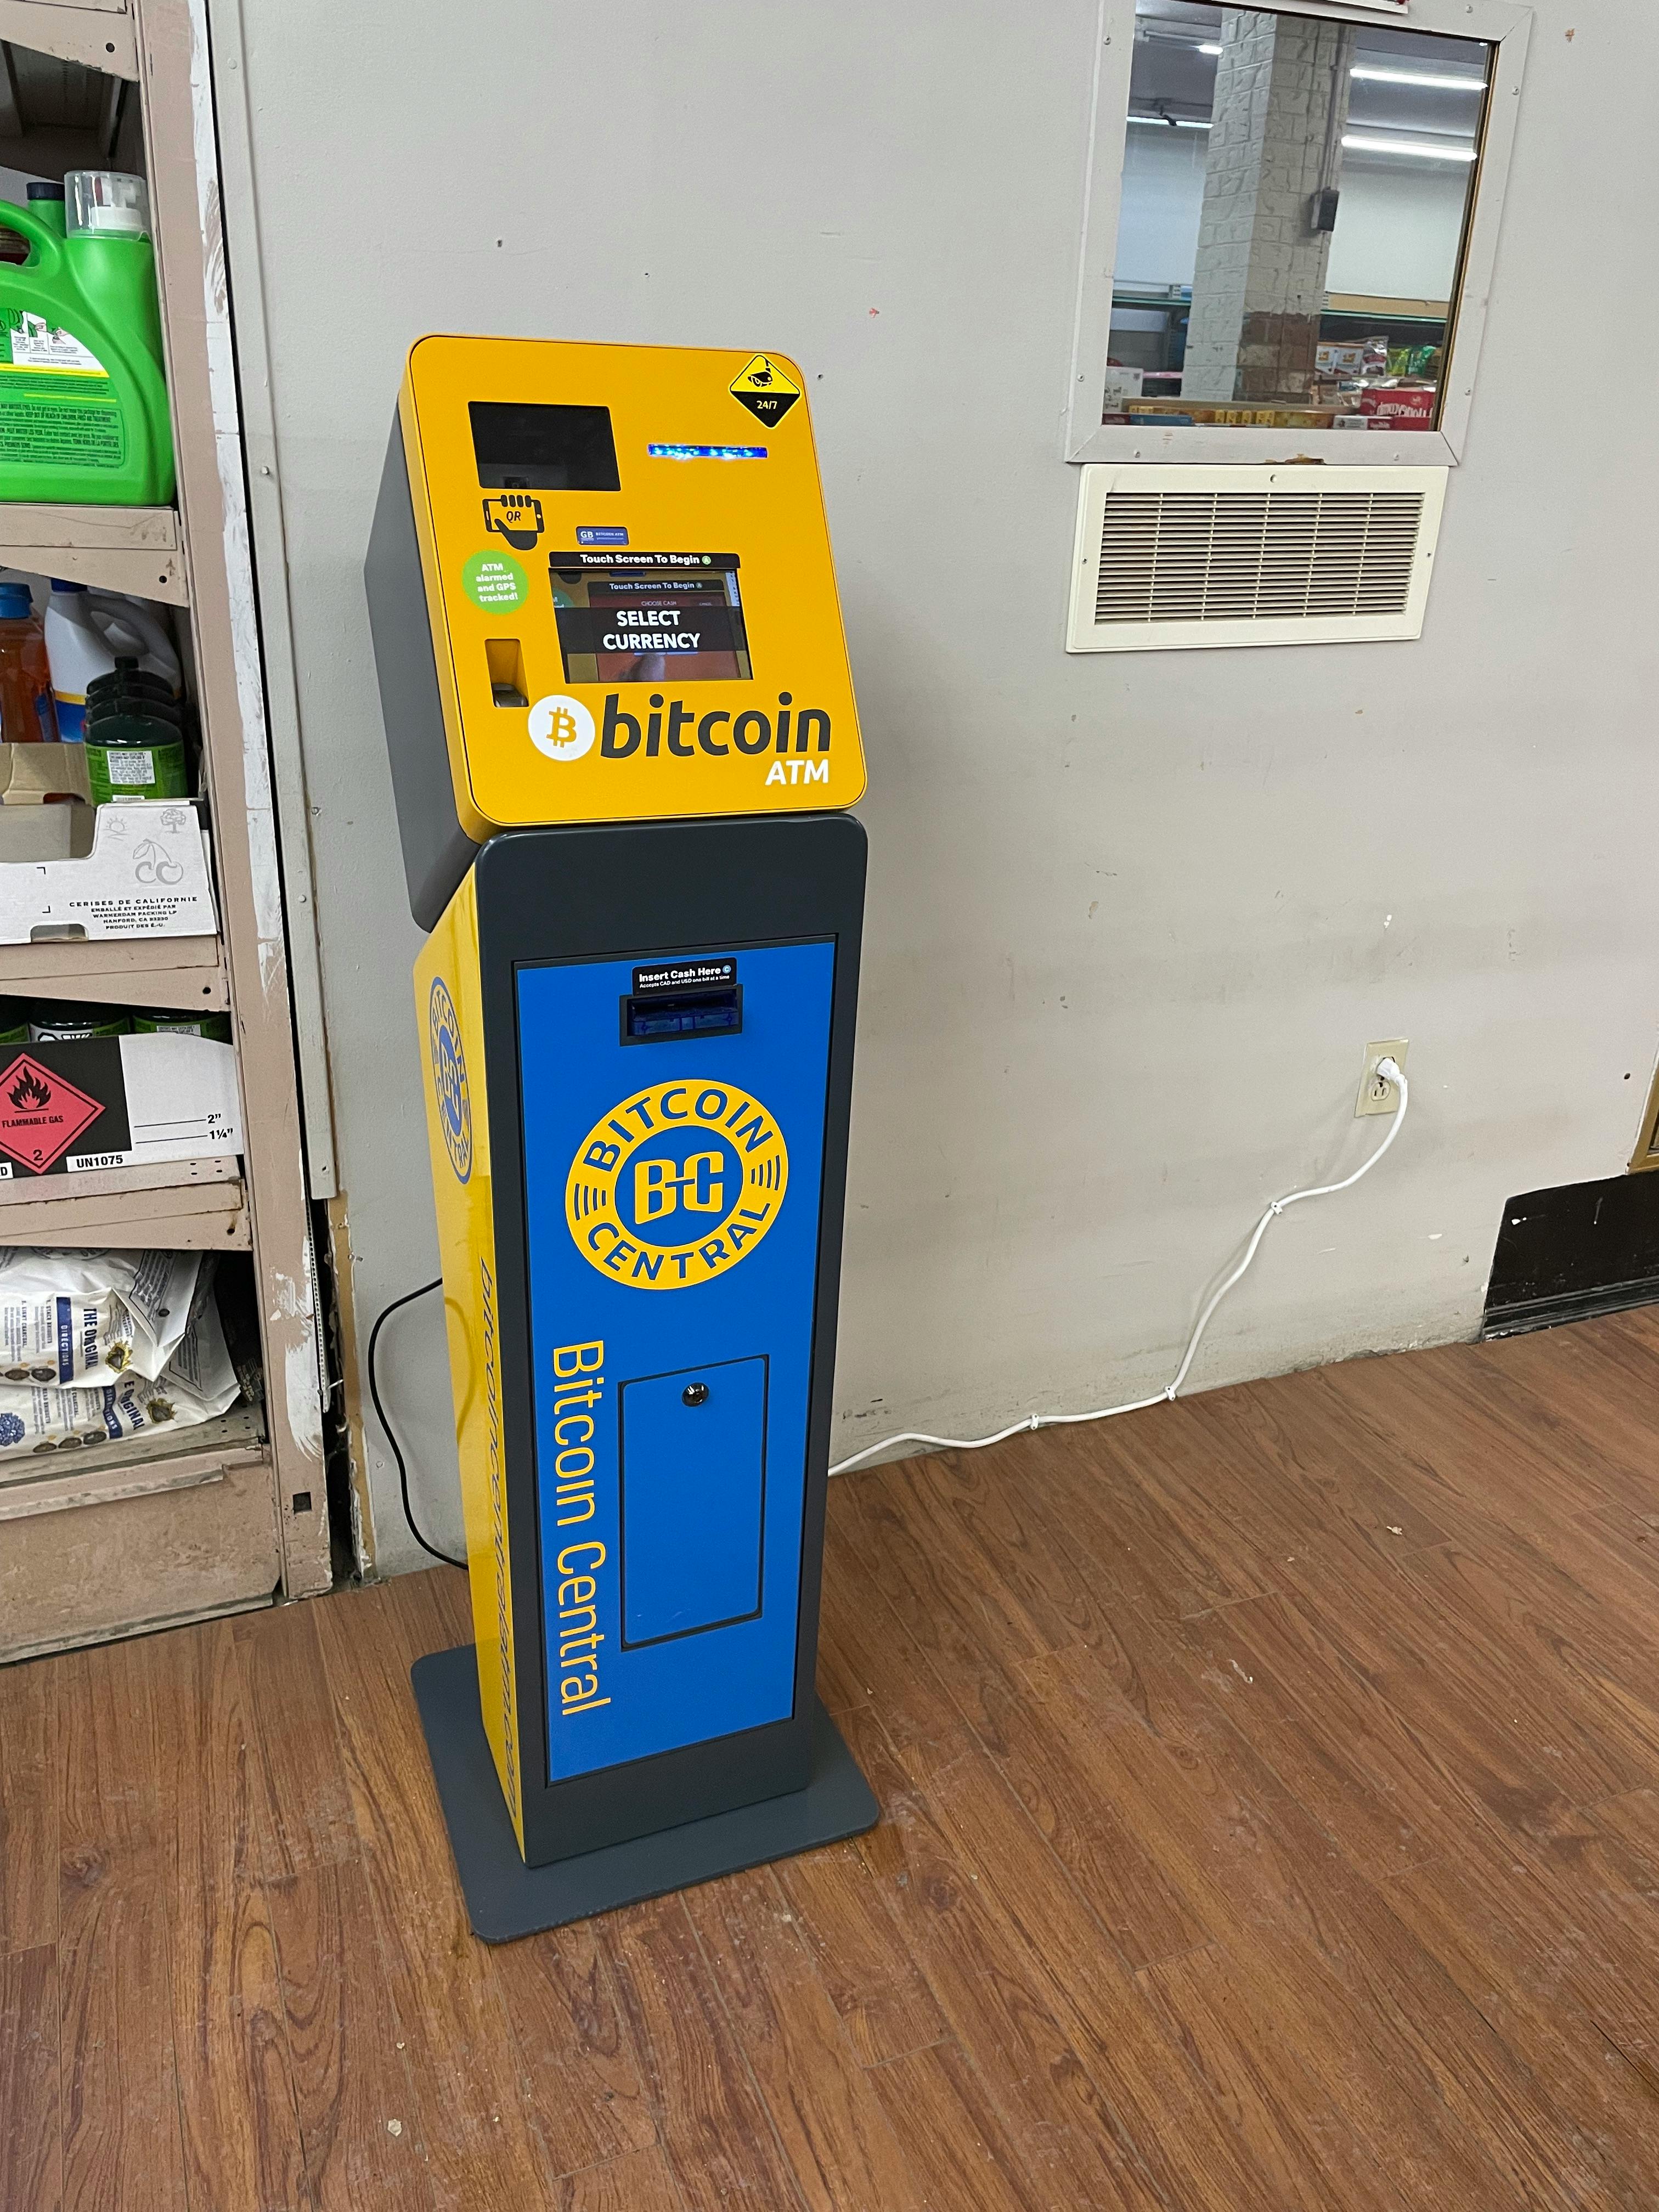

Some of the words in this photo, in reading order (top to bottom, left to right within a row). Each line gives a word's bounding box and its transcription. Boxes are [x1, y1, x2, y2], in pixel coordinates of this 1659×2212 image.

[756, 400, 777, 409] 24/7
[506, 510, 522, 523] QR
[481, 563, 504, 572] ATM
[580, 554, 613, 563] Touch
[615, 555, 653, 564] Screen
[655, 555, 668, 564] To
[670, 555, 700, 565] Begin
[476, 572, 514, 582] alarmed
[477, 583, 495, 592] and
[496, 582, 517, 592] GPS
[479, 592, 518, 602] tracked!
[616, 610, 681, 627] SELECT
[603, 633, 701, 651] CURRENCY
[600, 692, 832, 759] bitcoin
[765, 759, 829, 786] ATM
[639, 972, 669, 983] Insert
[670, 968, 696, 979] Cash
[698, 967, 721, 976] Here
[432, 990, 466, 1083] BITCOIN
[2, 1116, 47, 1128] FLAMMABLE
[583, 1088, 774, 1172] BITCOIN
[33, 1149, 43, 1161] 2
[76, 1154, 123, 1168] UN1075
[588, 1203, 771, 1281] CENTRAL
[83, 1308, 98, 1328] THE
[83, 1329, 99, 1370] ORIGINAL
[553, 1339, 605, 1527] Bitcoin
[557, 1541, 611, 1717] Central
